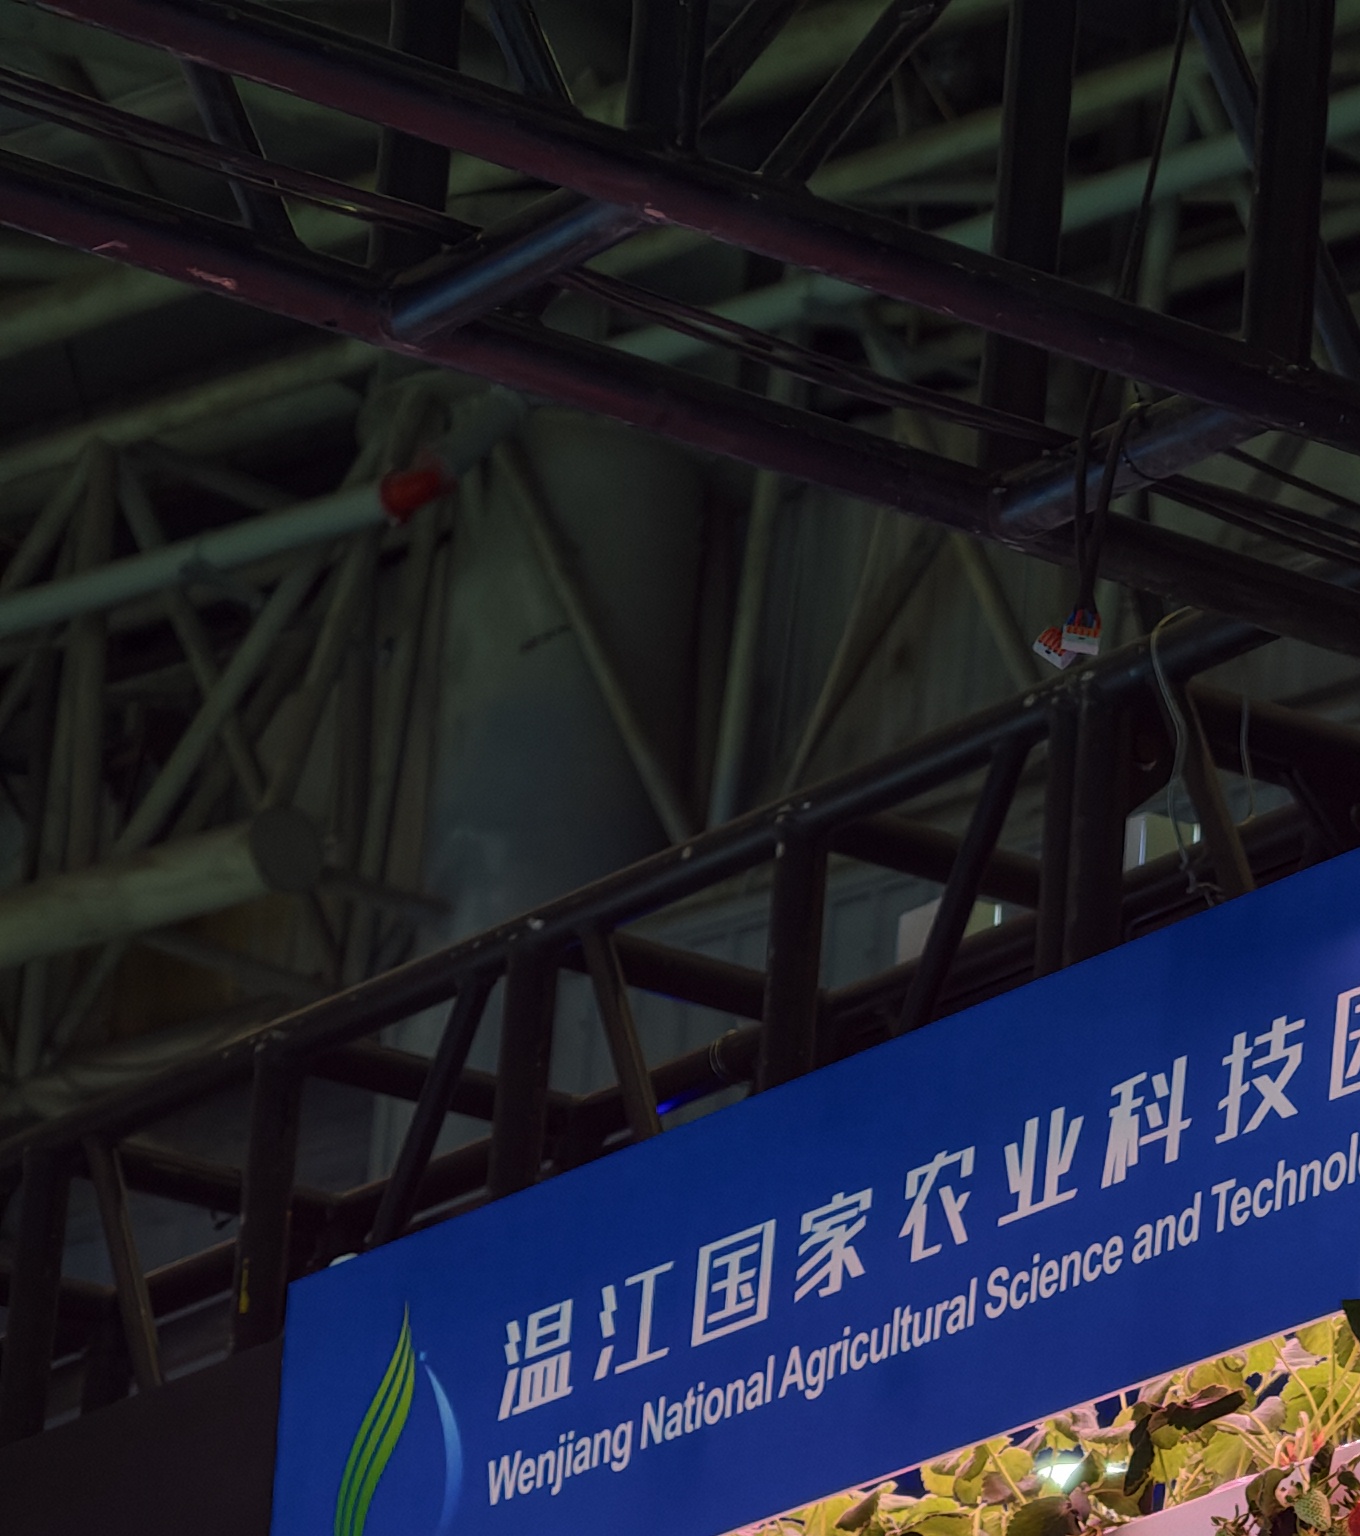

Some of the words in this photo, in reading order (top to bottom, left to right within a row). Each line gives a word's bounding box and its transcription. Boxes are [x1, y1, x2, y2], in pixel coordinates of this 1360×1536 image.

[488, 1420, 633, 1506] Wenjiang
[640, 1354, 776, 1450] National
[778, 1277, 978, 1400] Agricultural
[984, 1235, 1124, 1319] Science
[1131, 1191, 1202, 1265] and
